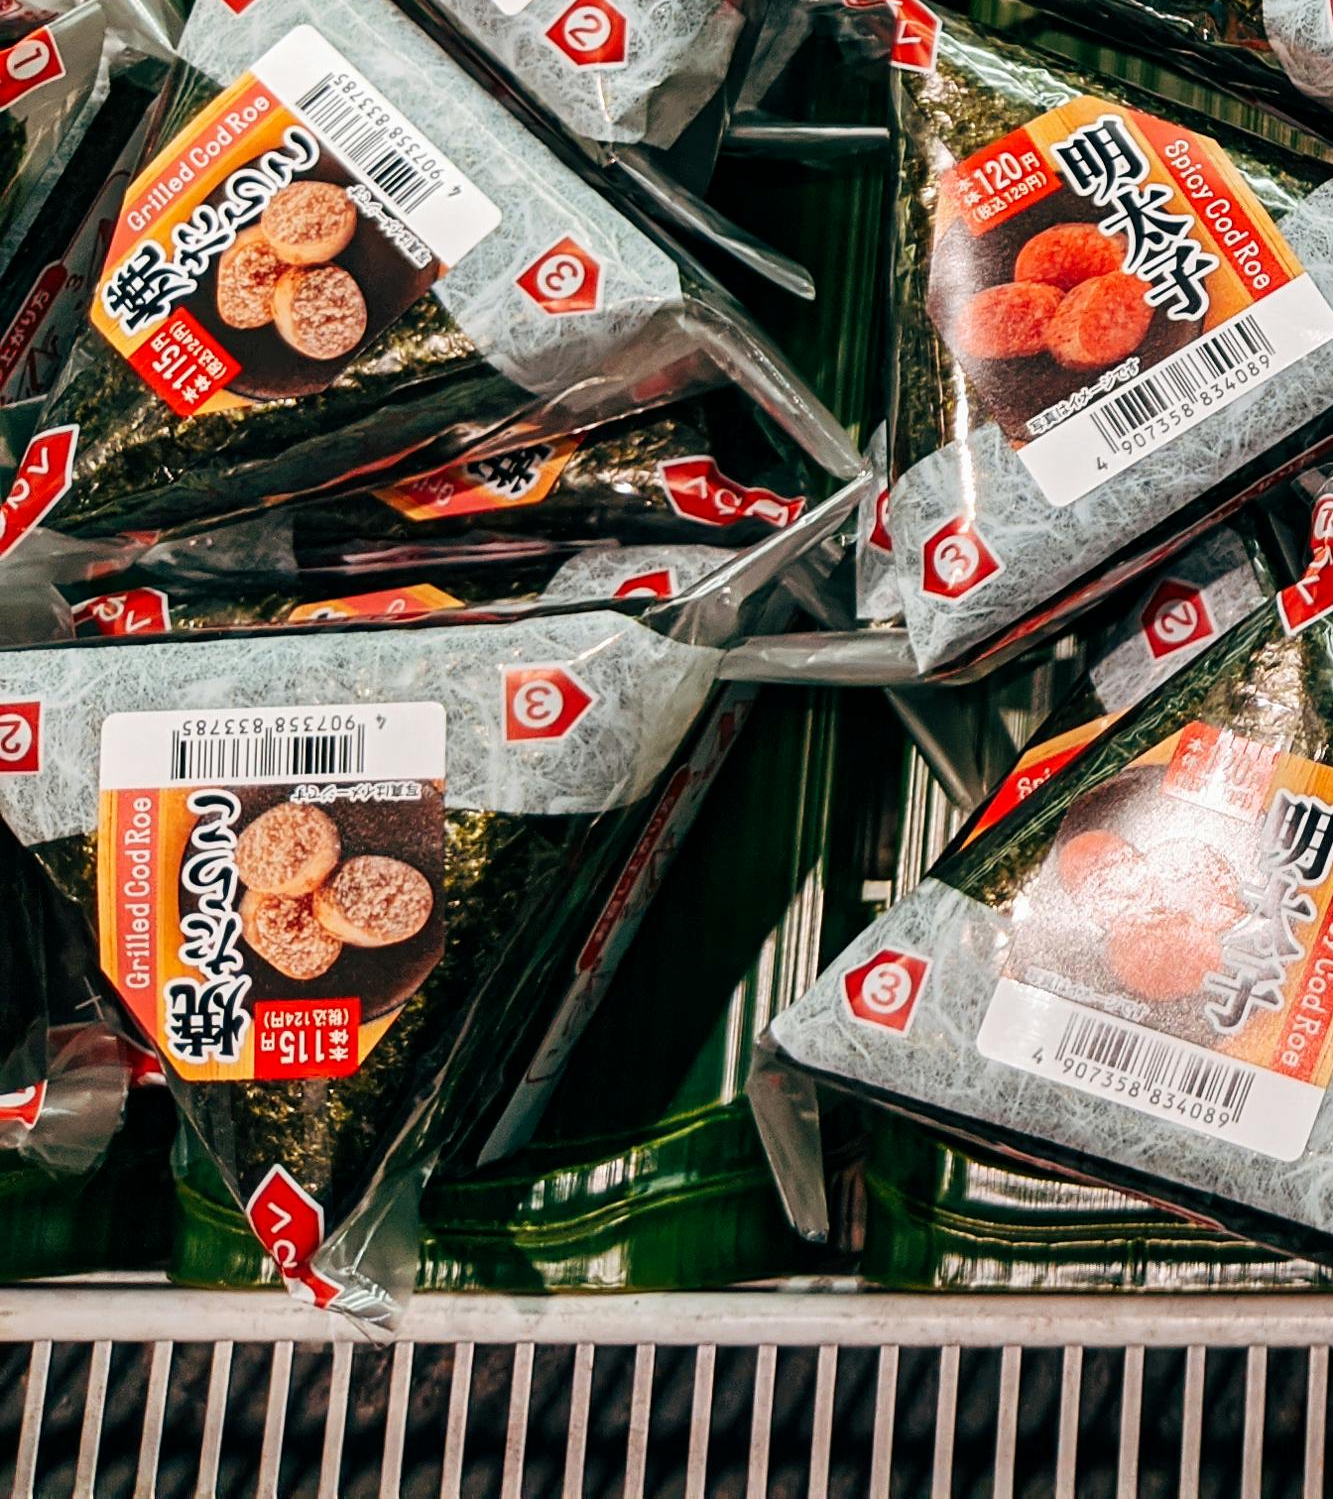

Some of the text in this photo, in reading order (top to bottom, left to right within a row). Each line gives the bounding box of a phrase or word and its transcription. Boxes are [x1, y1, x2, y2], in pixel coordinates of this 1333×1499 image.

[101, 129, 316, 332] 焼たらこ
[122, 90, 272, 233] Grilled Cod Roe
[967, 170, 1048, 226] (税込129円)
[1054, 119, 1216, 318] 明太子
[1160, 138, 1273, 292] Spicy Cod Roe
[166, 318, 228, 381] (税込124円)
[1093, 353, 1272, 474] 4 907358 834089
[123, 797, 151, 989] Grilled Cod Roe
[170, 794, 248, 1058] 焼たらこ
[264, 1008, 349, 1030] (税込124円)
[1279, 1016, 1322, 1069] Roe
